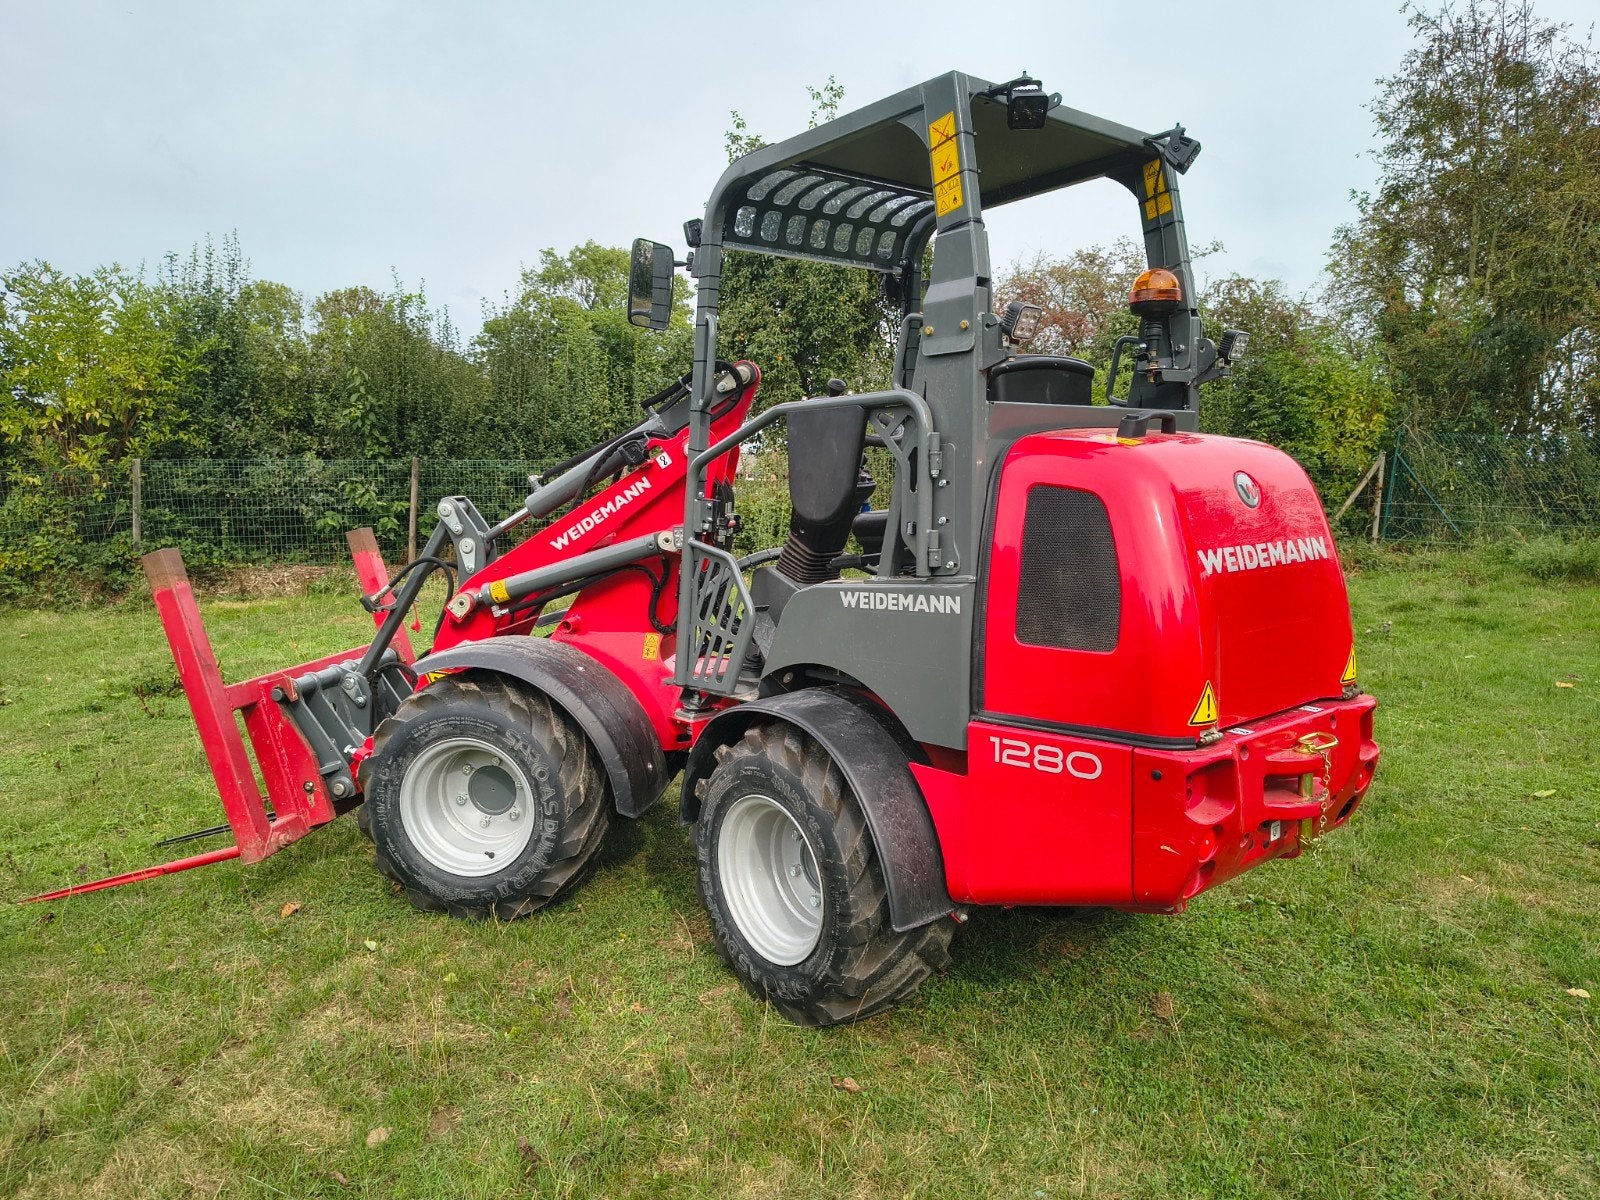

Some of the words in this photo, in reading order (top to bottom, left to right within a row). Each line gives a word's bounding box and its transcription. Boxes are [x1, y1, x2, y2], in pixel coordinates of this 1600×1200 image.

[550, 476, 652, 552] WEIDEMANN
[1198, 537, 1328, 576] WEIDEMANN
[840, 591, 960, 614] WEIDEMANN
[989, 736, 1103, 780] 1280
